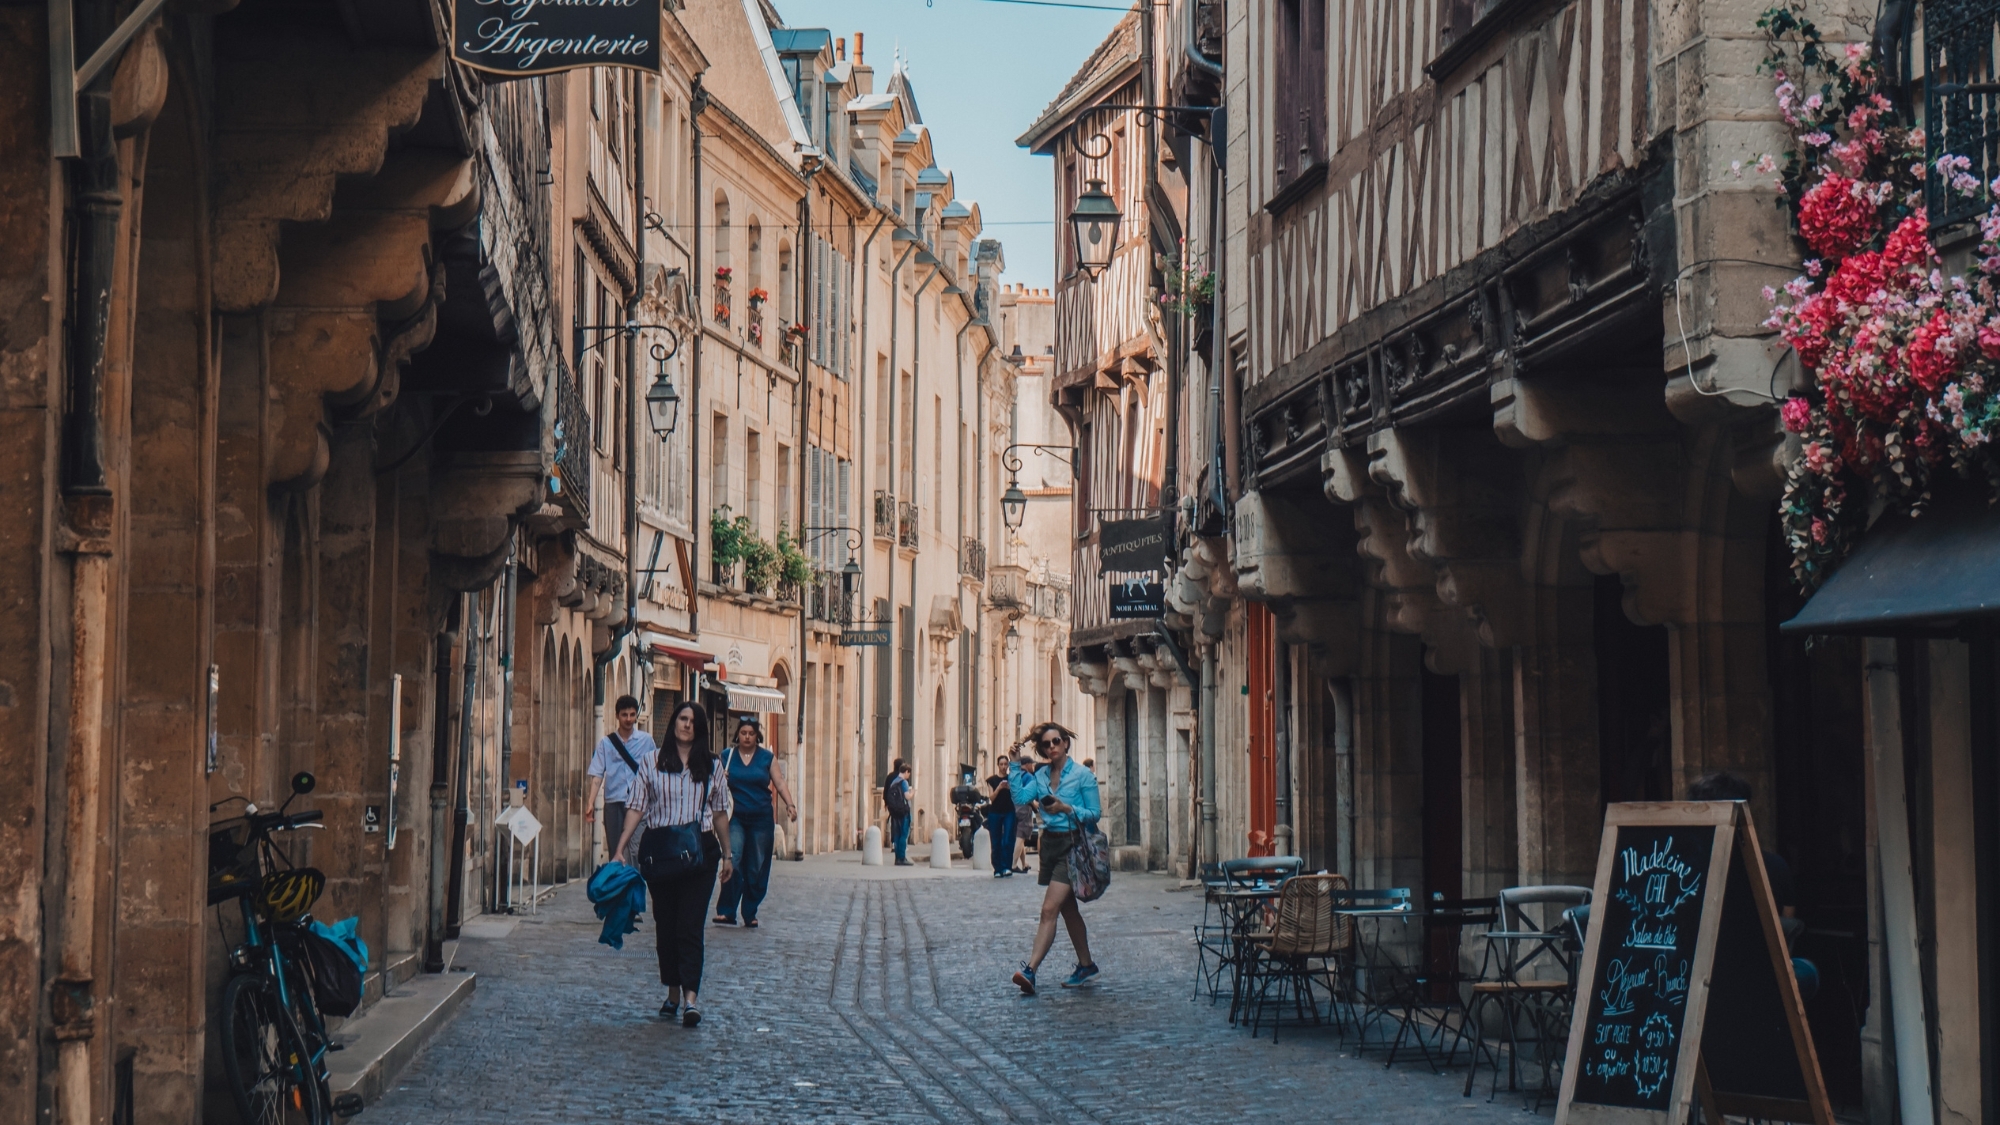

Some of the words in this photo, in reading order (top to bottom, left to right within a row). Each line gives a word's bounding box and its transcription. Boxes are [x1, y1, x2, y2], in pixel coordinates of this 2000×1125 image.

[463, 17, 649, 69] Argenterie
[1115, 604, 1132, 612] NOIR
[1133, 604, 1159, 612] ANIMAL
[840, 632, 888, 643] OPTICIENS
[1620, 835, 1701, 892] Madeleine
[1626, 918, 1652, 947] Salon
[1653, 924, 1663, 945] de
[1663, 923, 1678, 945] thé
[1654, 954, 1688, 998] Brunch
